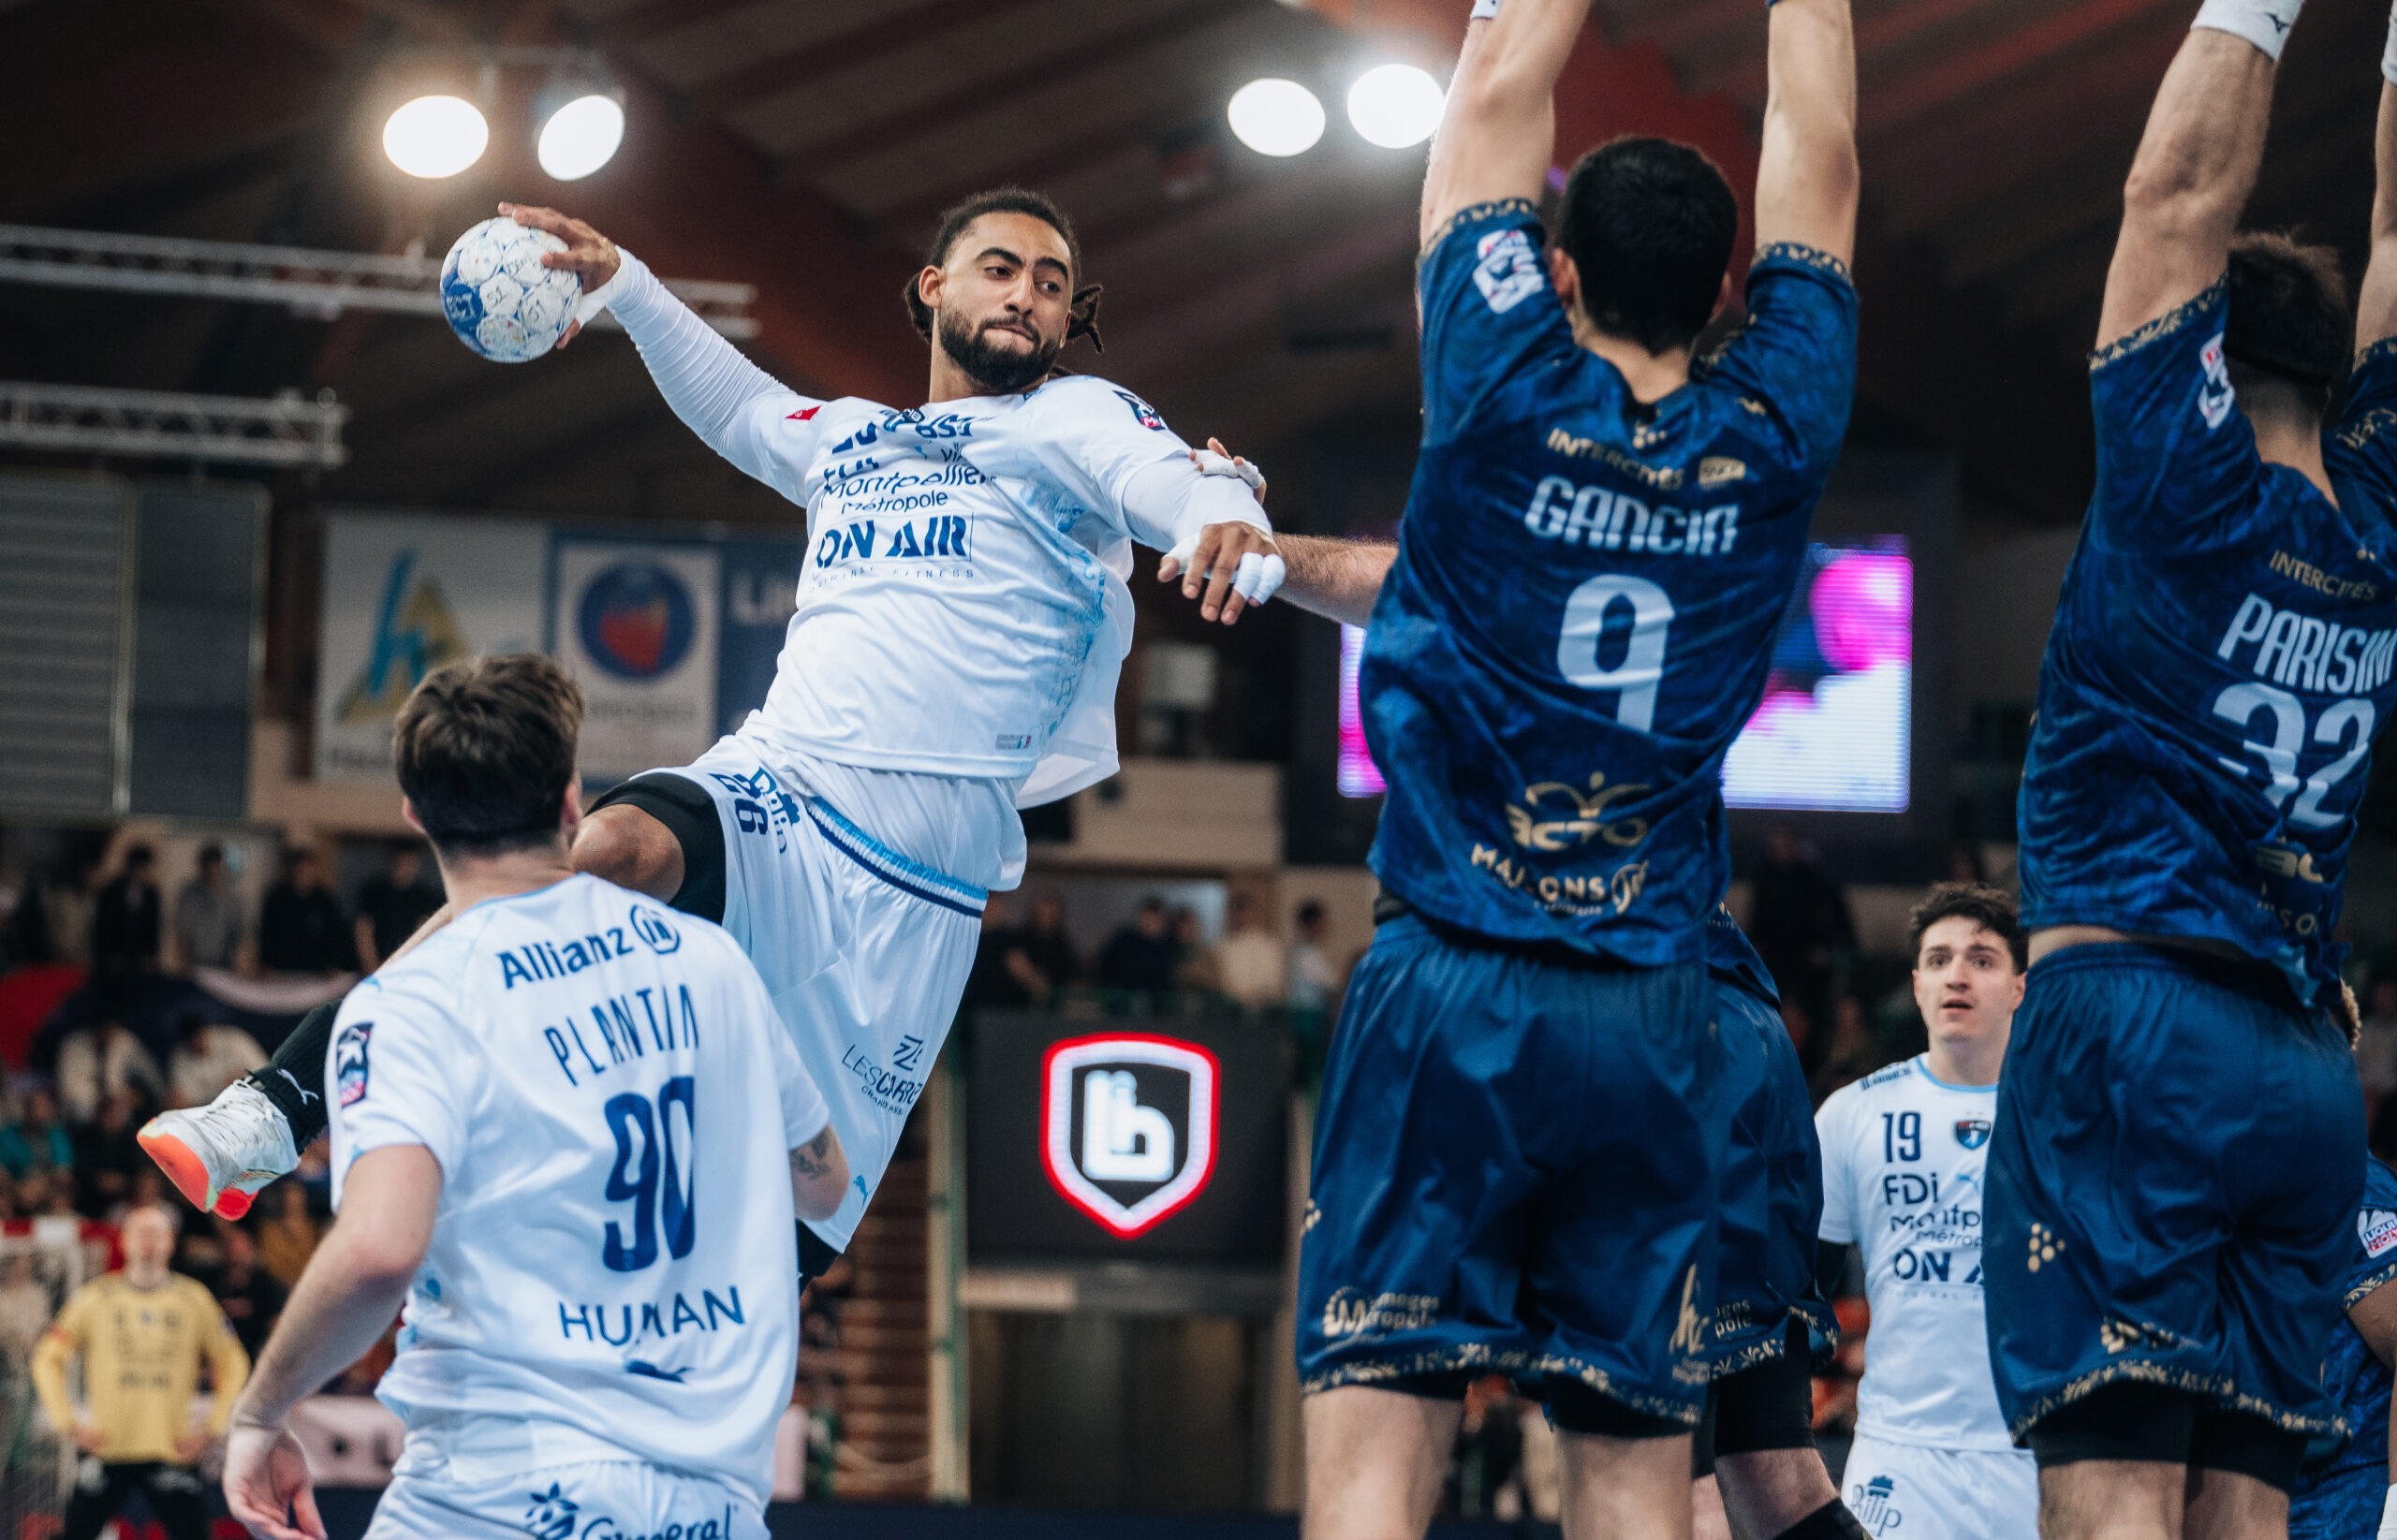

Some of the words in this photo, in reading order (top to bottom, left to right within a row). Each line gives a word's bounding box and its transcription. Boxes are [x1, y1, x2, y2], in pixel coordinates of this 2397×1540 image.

[816, 520, 875, 568] ON
[885, 516, 966, 557] AIR
[1557, 573, 1675, 733] 9
[2213, 682, 2375, 828] 32
[496, 925, 634, 990] Allianz
[1882, 1111, 1920, 1163] 19
[604, 1077, 696, 1271] 90
[1894, 1248, 1951, 1281] ON
